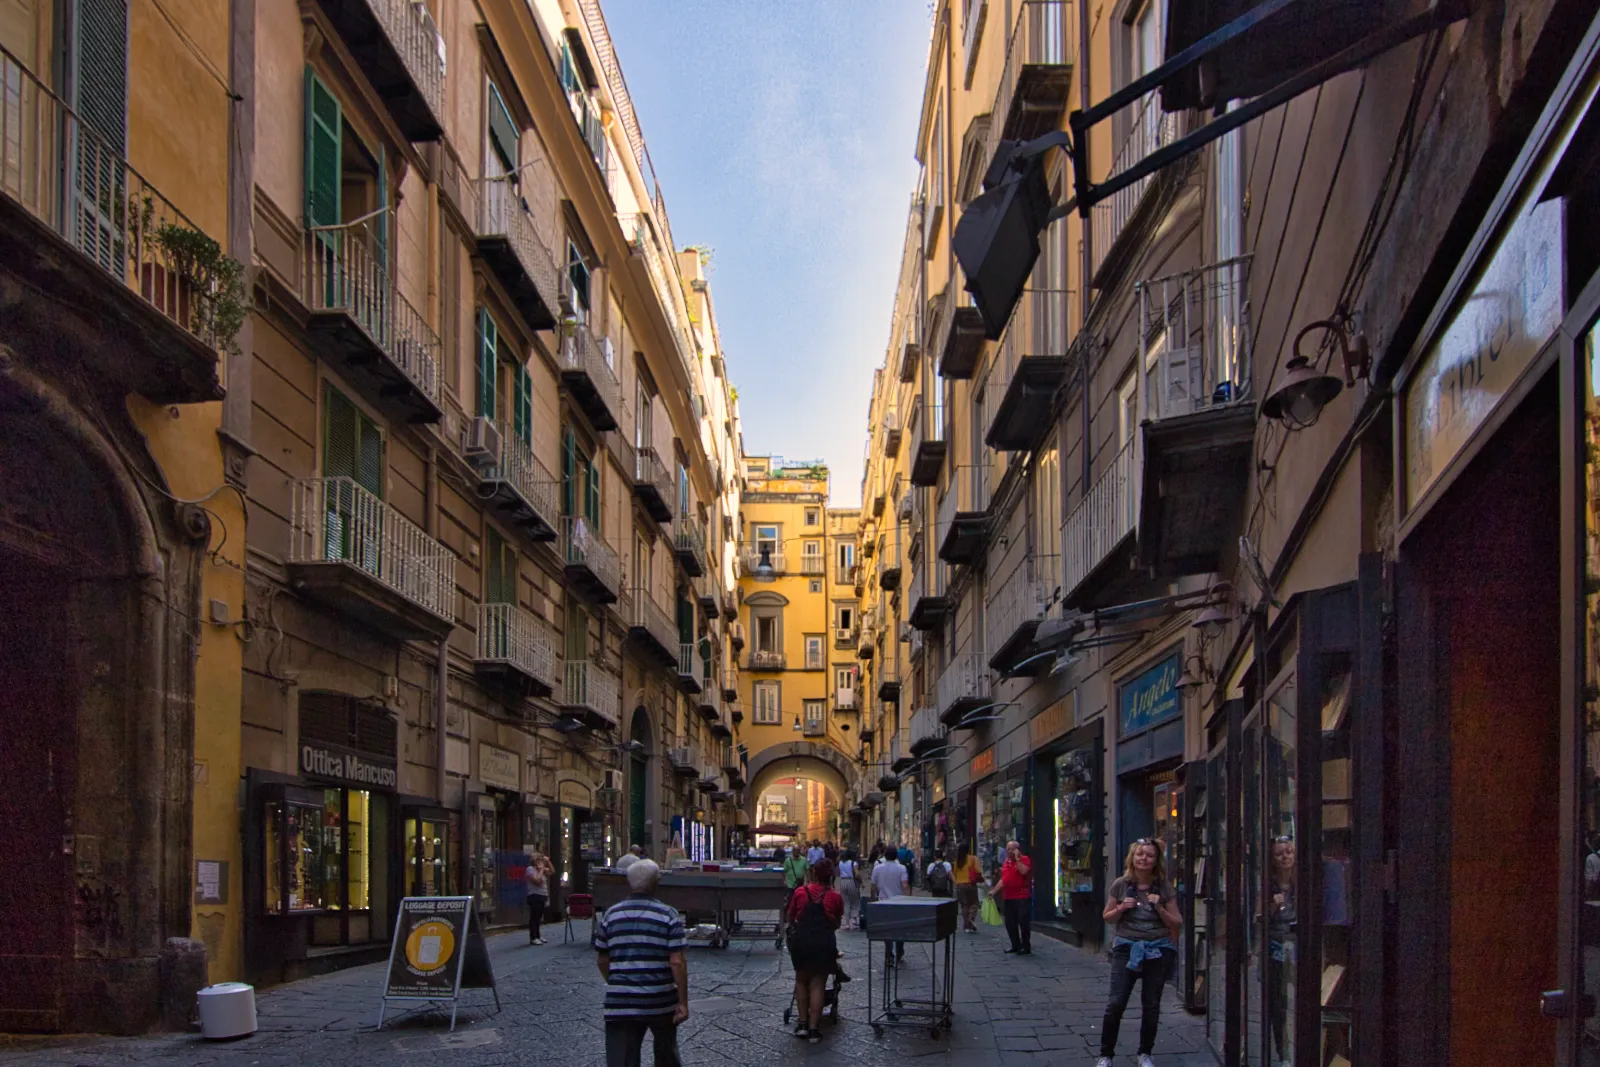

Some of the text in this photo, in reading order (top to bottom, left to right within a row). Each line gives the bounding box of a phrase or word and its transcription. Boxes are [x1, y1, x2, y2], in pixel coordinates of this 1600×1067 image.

[1124, 664, 1176, 729] Angelo
[302, 745, 396, 787] Ottica Mancuso
[405, 901, 465, 909] LUGGAGE DEPOSIT
